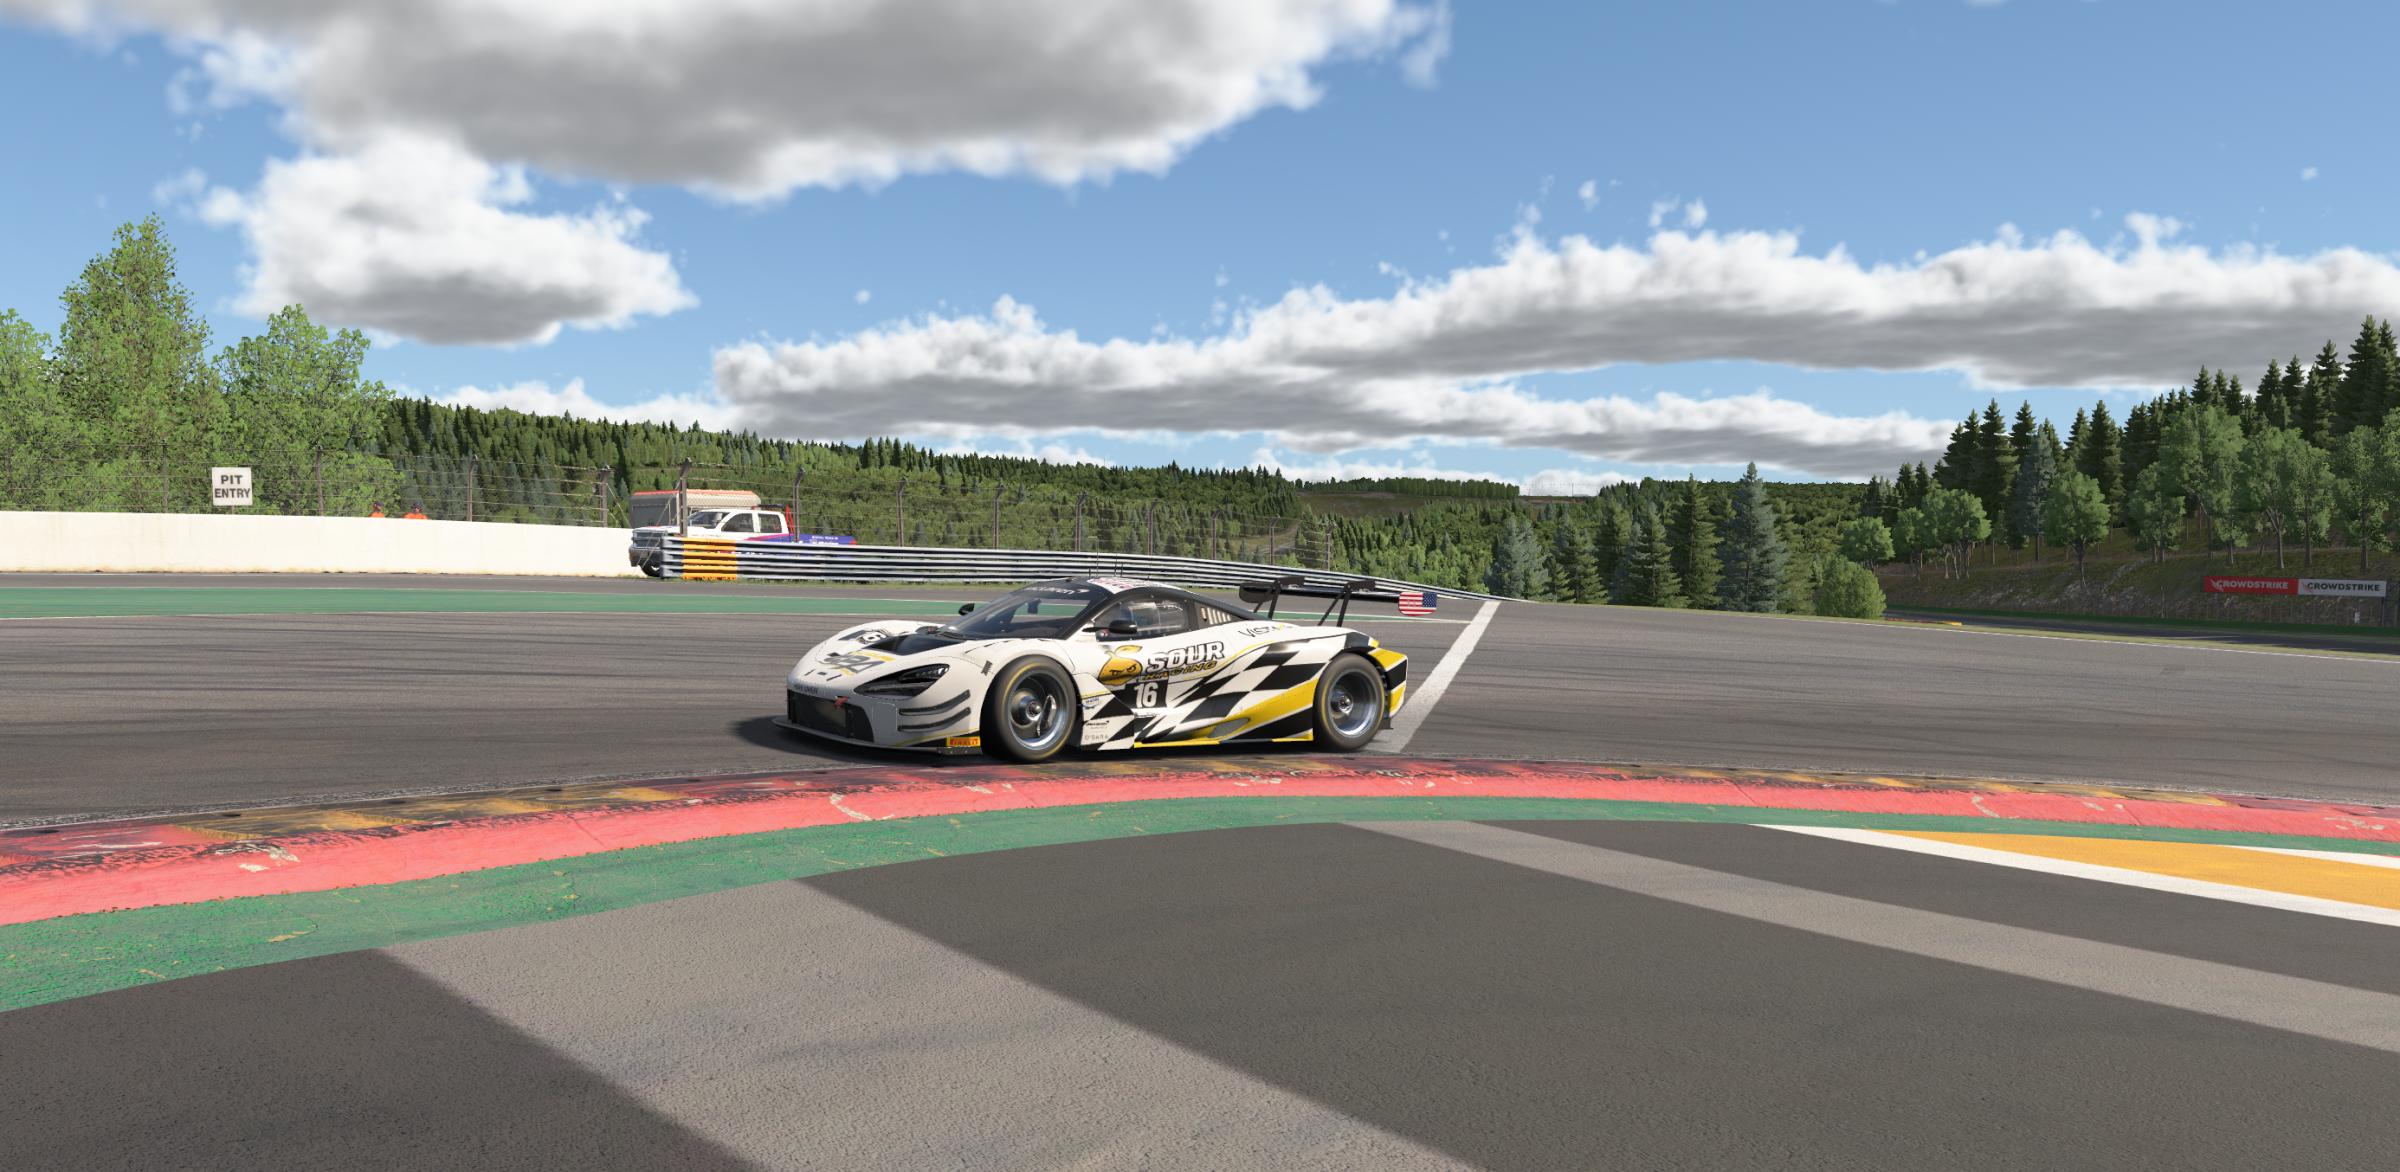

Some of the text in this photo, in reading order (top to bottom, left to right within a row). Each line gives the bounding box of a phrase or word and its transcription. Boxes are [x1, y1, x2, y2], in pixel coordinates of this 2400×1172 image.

[221, 475, 243, 485] PIT
[215, 488, 251, 498] ENTRY
[2217, 580, 2289, 590] CROWDSTRIKE
[2307, 582, 2381, 592] CROWDSTRIKE
[1146, 641, 1225, 673] SOUR
[1134, 682, 1159, 709] 16
